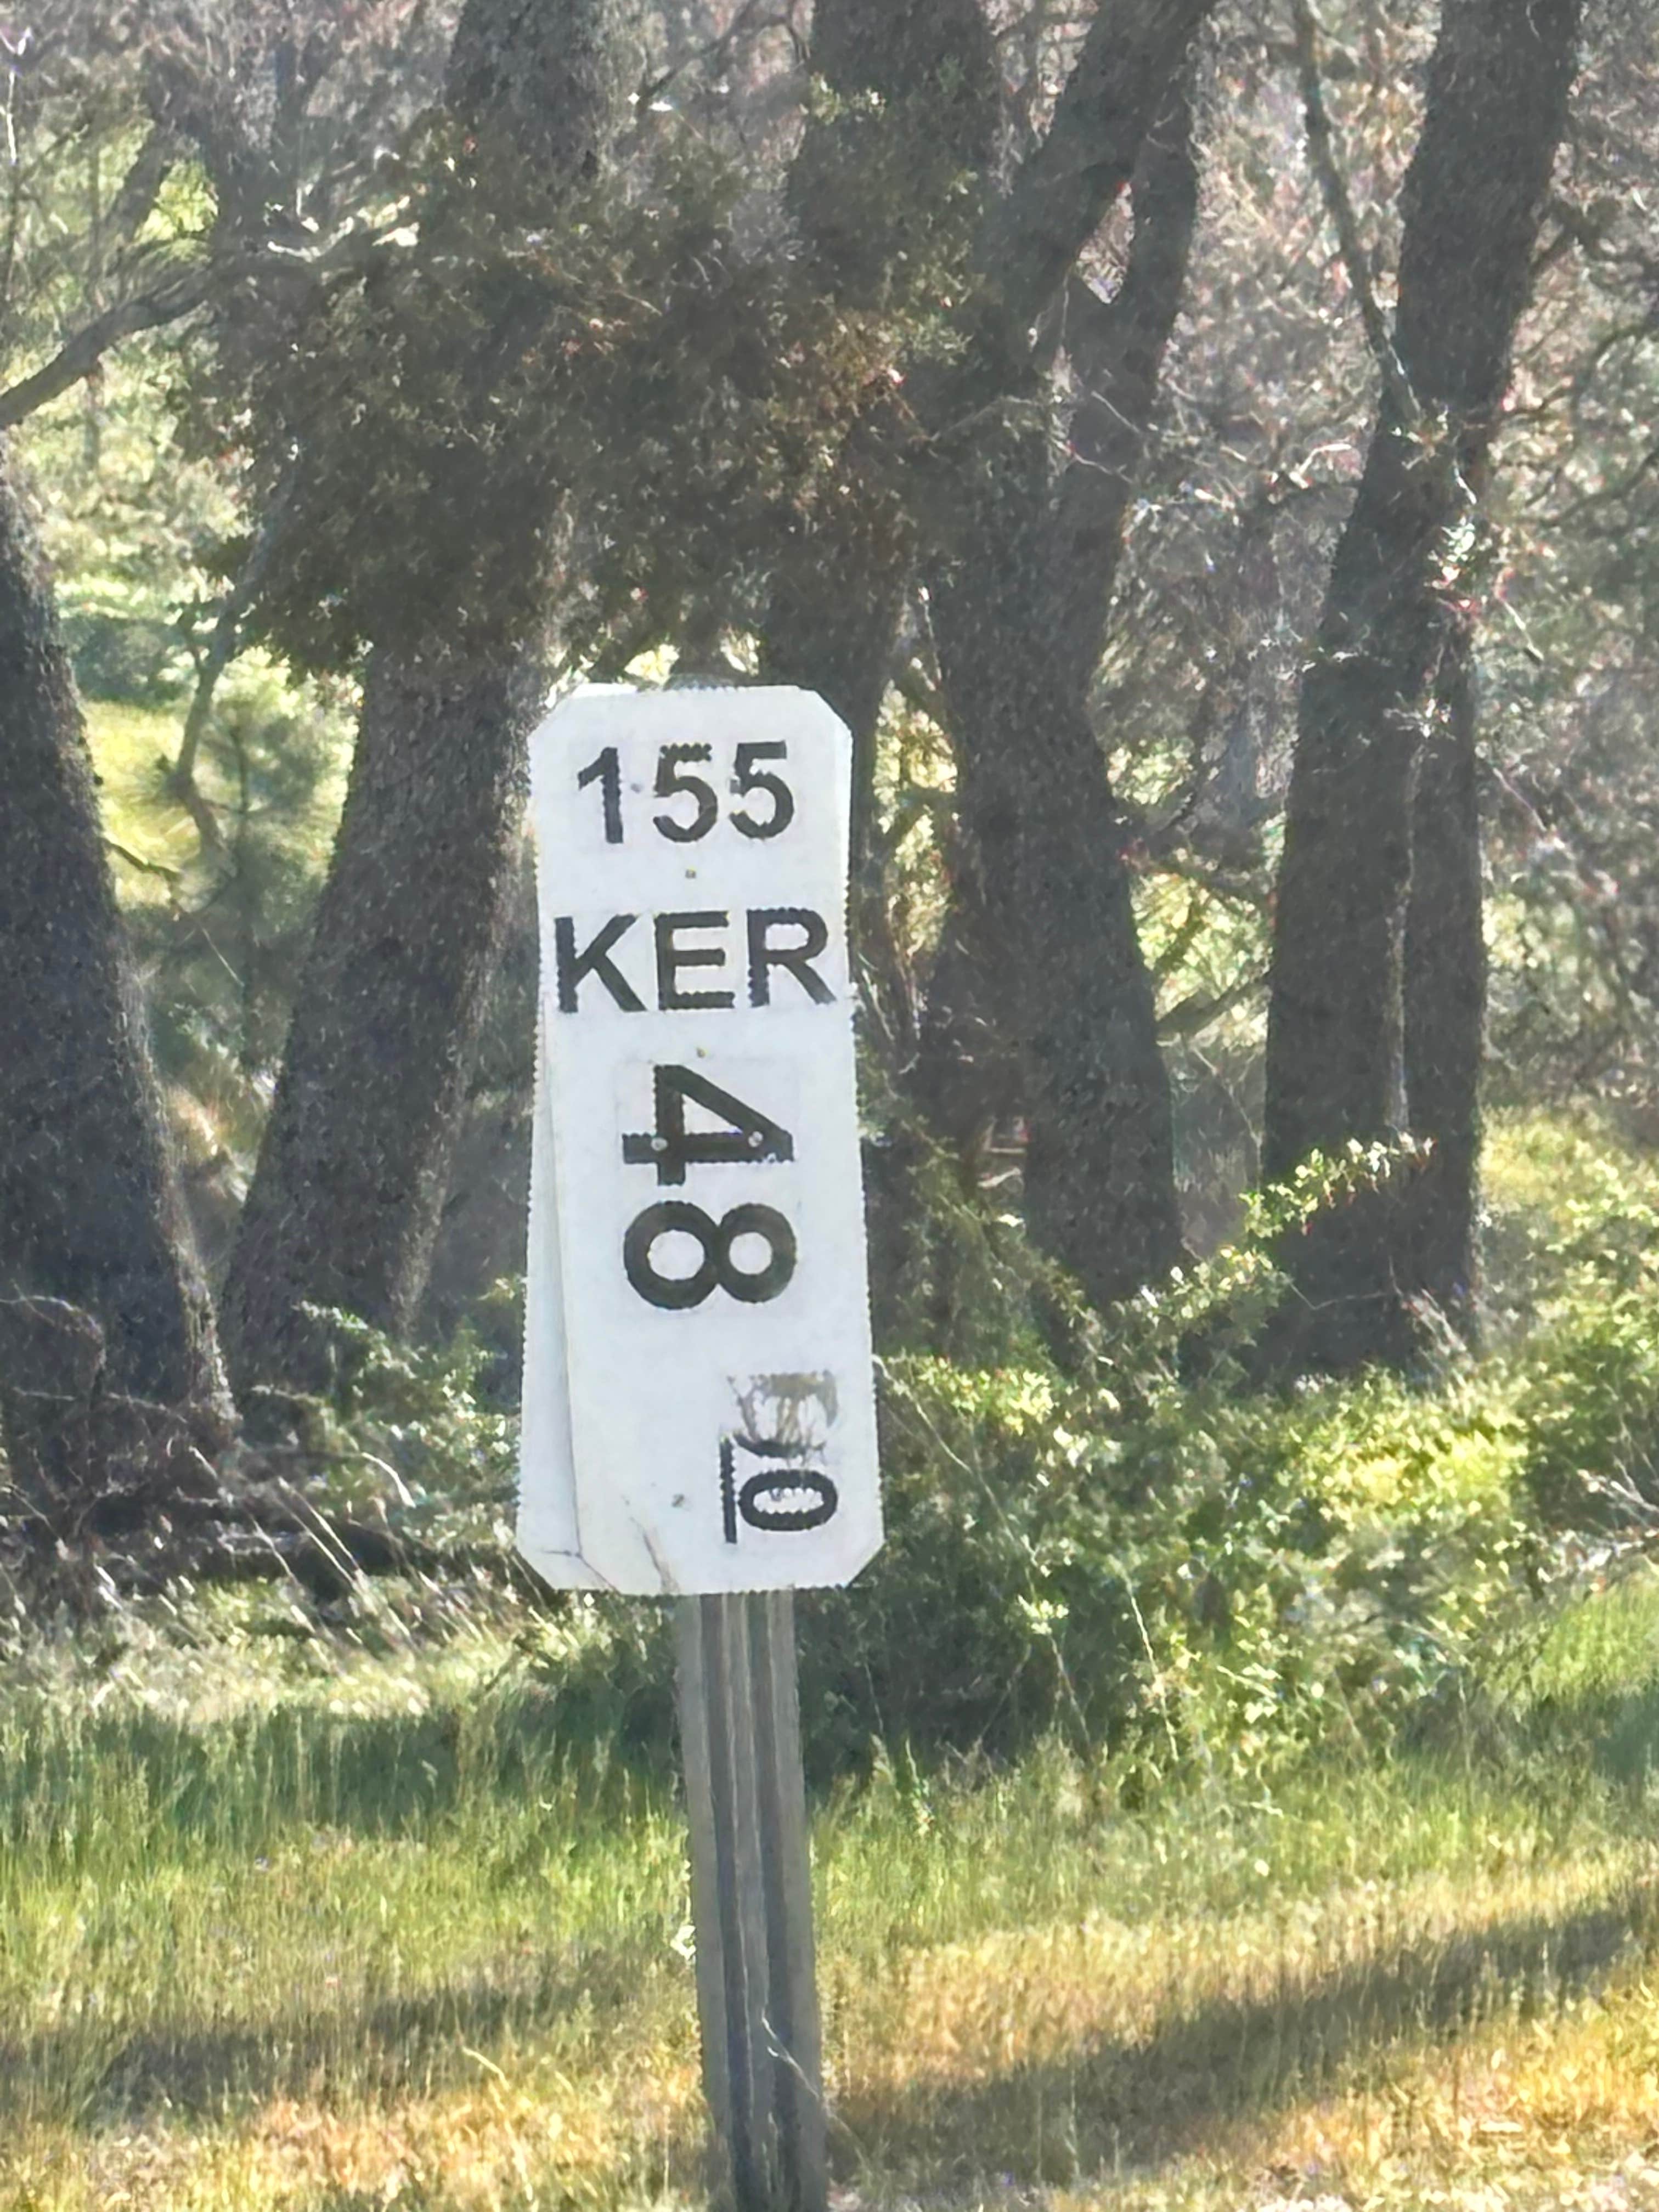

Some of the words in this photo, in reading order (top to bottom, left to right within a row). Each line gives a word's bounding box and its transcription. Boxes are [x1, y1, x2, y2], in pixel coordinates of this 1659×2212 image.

[577, 740, 795, 844] 155
[554, 907, 837, 1014] KER
[622, 1064, 798, 1310] 48
